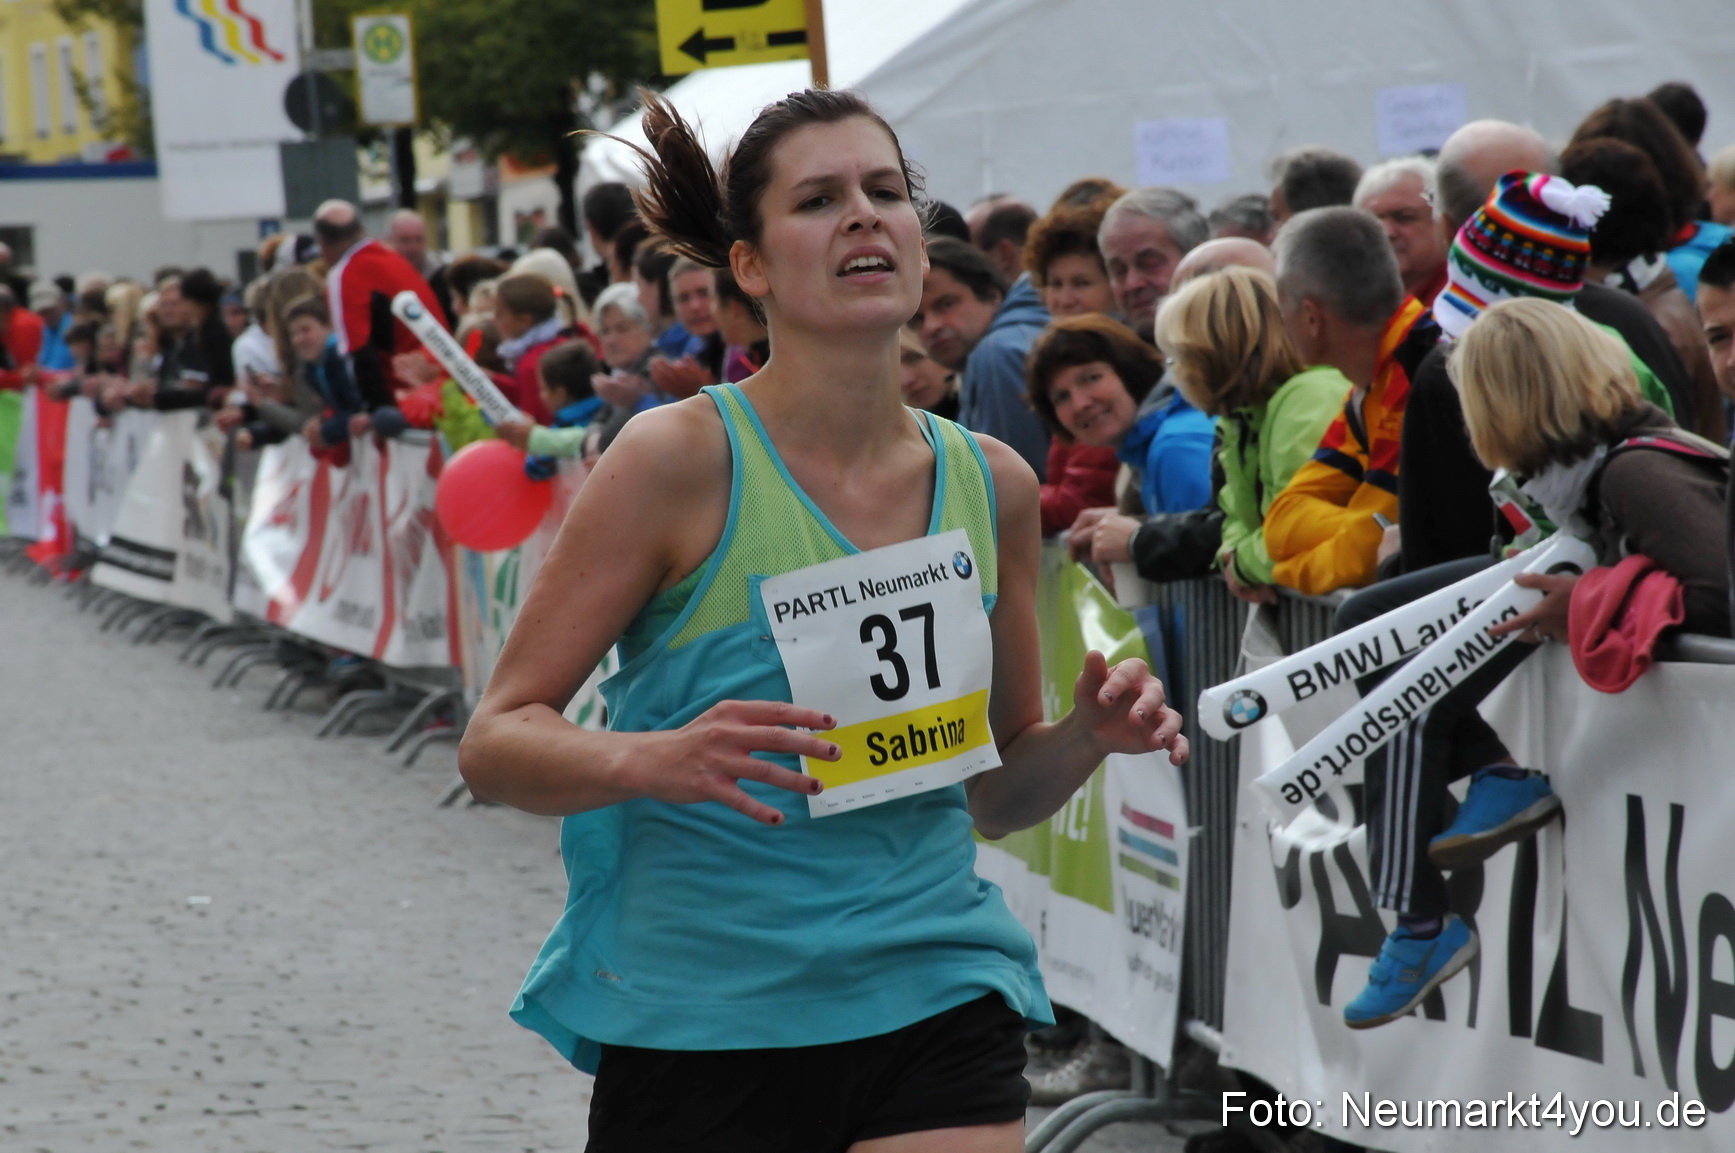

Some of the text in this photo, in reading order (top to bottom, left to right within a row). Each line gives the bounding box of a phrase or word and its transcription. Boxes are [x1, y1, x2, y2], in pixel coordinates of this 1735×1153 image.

[773, 562, 949, 624] PARTL Neumarkt
[859, 601, 942, 702] 37
[1286, 635, 1384, 702] BMW
[866, 716, 966, 766] Sabrina
